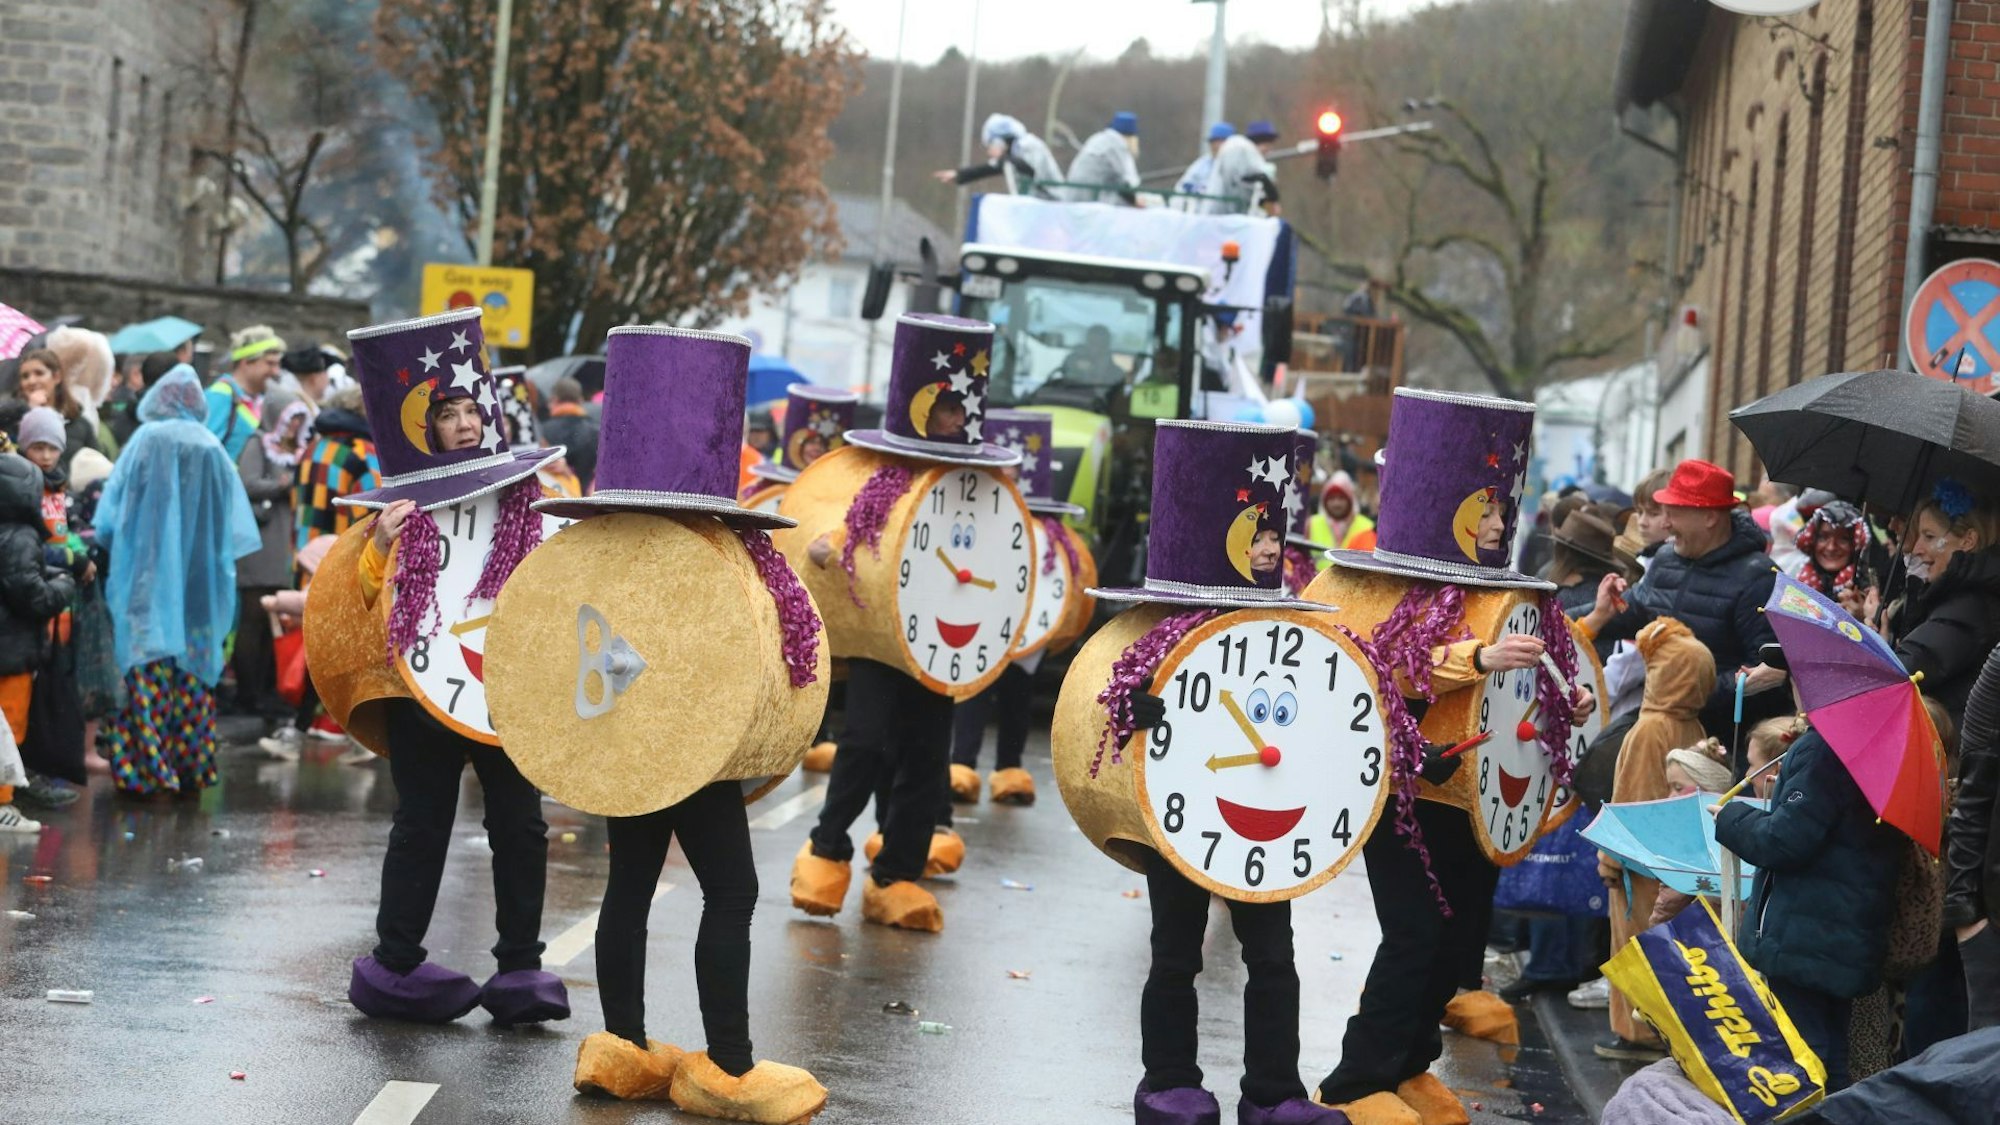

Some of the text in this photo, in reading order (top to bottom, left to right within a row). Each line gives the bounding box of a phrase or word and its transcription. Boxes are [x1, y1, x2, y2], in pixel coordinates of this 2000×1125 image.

[931, 486, 945, 515] 11
[959, 473, 977, 502] 12
[992, 487, 1000, 514] 1
[449, 502, 477, 541] 11
[912, 521, 930, 552] 10
[1012, 522, 1023, 550] 2
[900, 559, 910, 588] 9
[1016, 565, 1027, 593] 3
[1052, 578, 1064, 600] 3
[908, 614, 918, 643] 8
[1000, 616, 1011, 644] 4
[1038, 610, 1048, 630] 4
[410, 635, 429, 673] 8
[928, 644, 938, 672] 7
[976, 645, 987, 673] 5
[1218, 634, 1248, 677] 11
[1266, 625, 1304, 667] 12
[950, 652, 961, 682] 6
[1325, 651, 1338, 692] 1
[446, 677, 466, 714] 7
[1175, 669, 1211, 713] 10
[1350, 692, 1373, 732] 2
[1479, 698, 1489, 733] 9
[1149, 720, 1172, 761] 9
[1360, 746, 1381, 786] 3
[1479, 756, 1489, 796] 8
[1536, 774, 1546, 812] 4
[1164, 792, 1185, 833] 8
[1332, 807, 1352, 848] 4
[1489, 796, 1500, 835] 7
[1503, 812, 1514, 850] 6
[1519, 805, 1530, 842] 5
[1201, 831, 1222, 871] 7
[1244, 846, 1266, 887] 6
[1293, 838, 1312, 878] 5
[1673, 939, 1761, 1058] Tchibo
